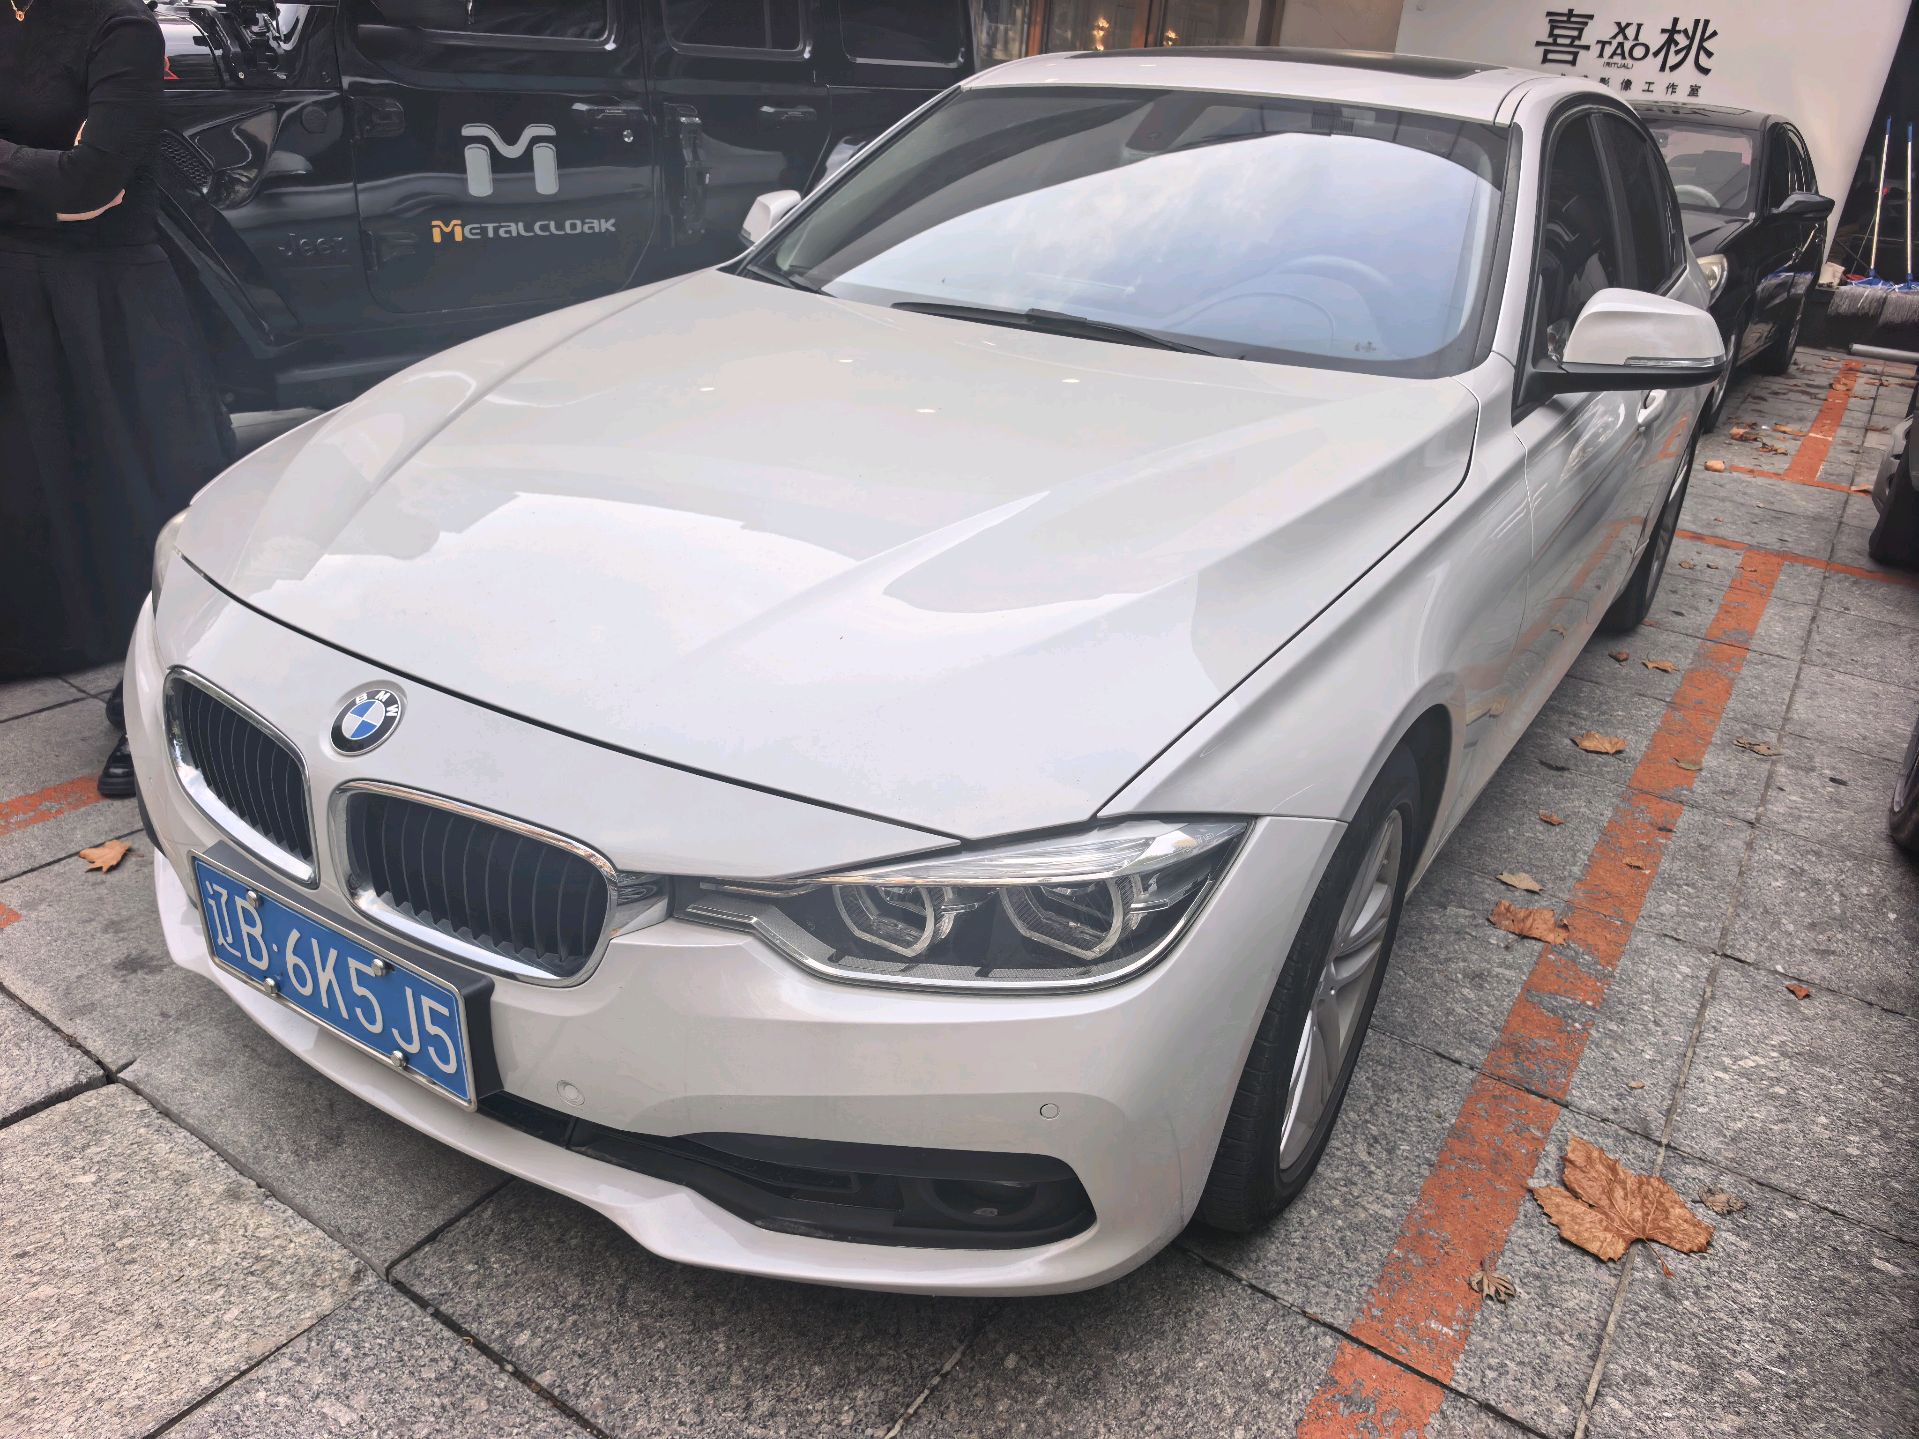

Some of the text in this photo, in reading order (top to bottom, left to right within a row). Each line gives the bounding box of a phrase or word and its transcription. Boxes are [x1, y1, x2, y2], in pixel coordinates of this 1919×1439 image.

[1535, 8, 1719, 76] 喜 桃
[1609, 21, 1644, 42] XI
[1595, 40, 1651, 61] TAO
[1560, 72, 1702, 98] 影像工作室
[355, 690, 400, 717] BMW
